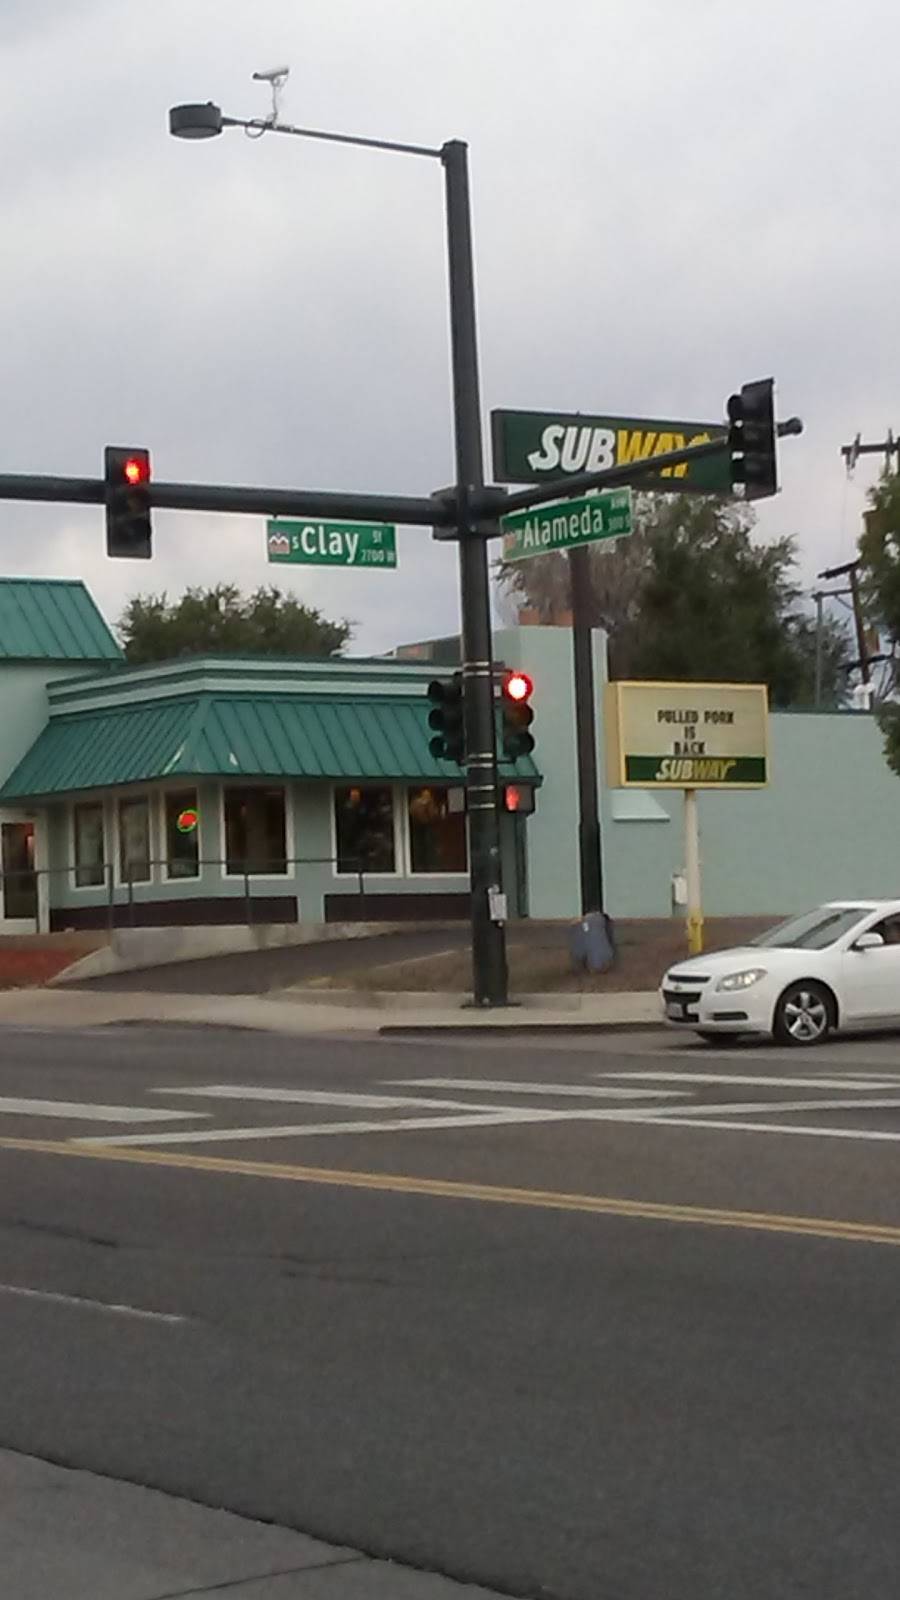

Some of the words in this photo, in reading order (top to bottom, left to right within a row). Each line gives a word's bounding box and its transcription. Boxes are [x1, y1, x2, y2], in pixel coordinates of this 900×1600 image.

[523, 504, 603, 549] Alameda
[301, 525, 359, 564] Clay
[657, 709, 699, 724] PULLED
[704, 710, 734, 725] PORK
[684, 725, 695, 740] IS
[673, 741, 706, 755] BACK
[655, 758, 737, 781] SUBWAY
